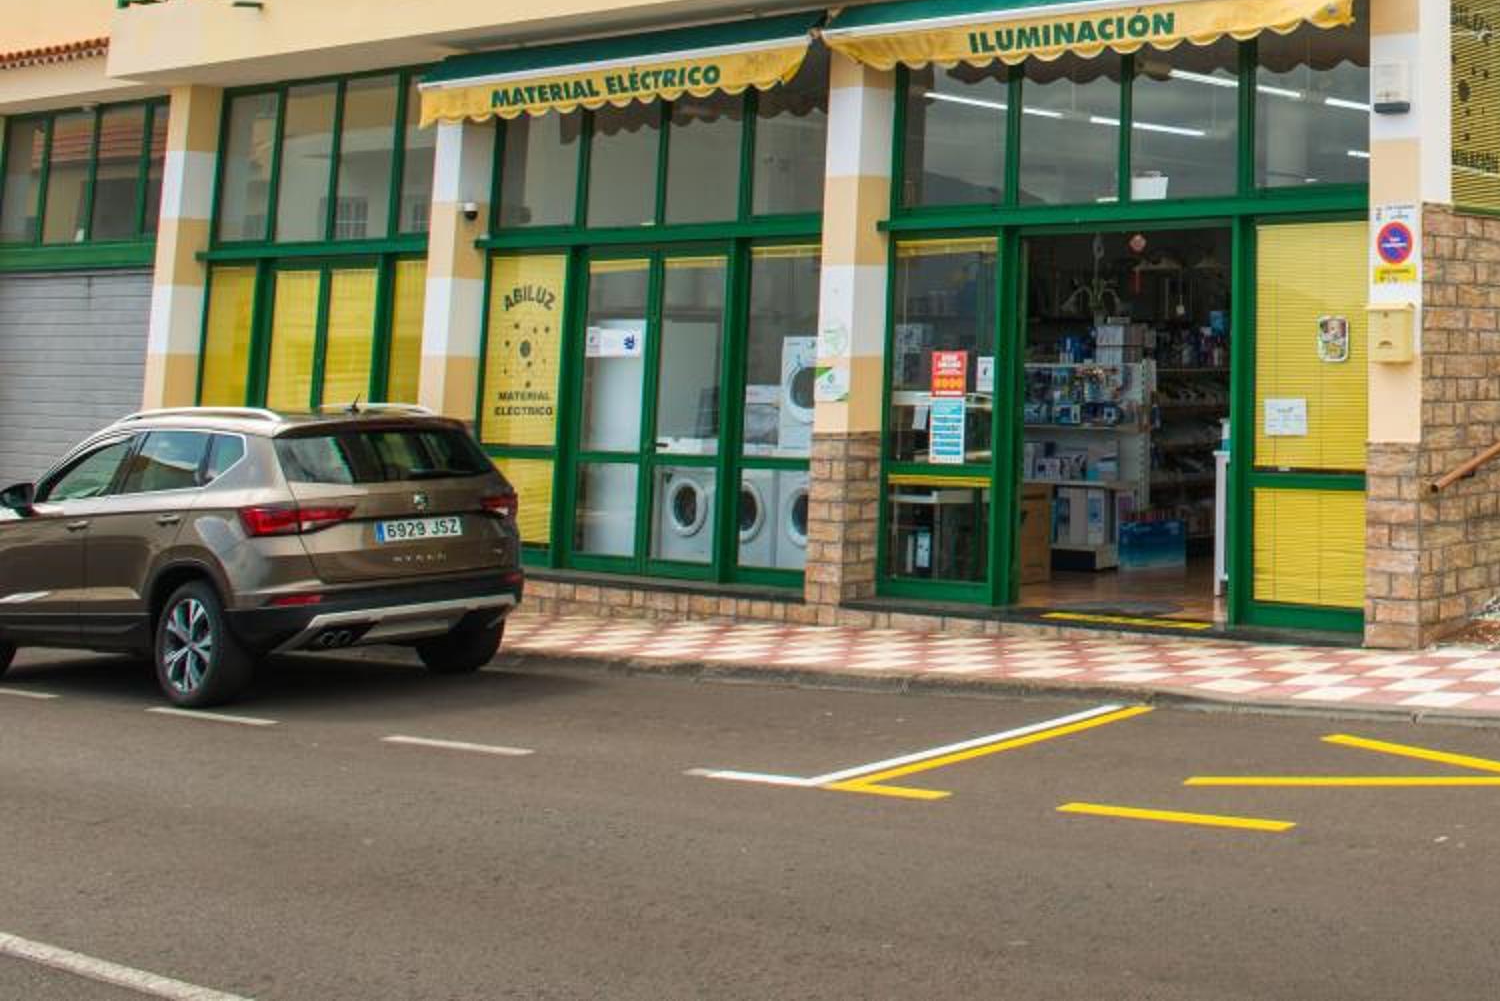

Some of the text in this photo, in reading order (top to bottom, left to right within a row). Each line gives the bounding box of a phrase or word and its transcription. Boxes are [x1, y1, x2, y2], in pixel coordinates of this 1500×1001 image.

[968, 6, 1176, 55] ILUMINACIÓN
[490, 64, 721, 109] MATERIAL ELÉCTRICO
[503, 284, 556, 312] ABILUZ
[497, 390, 551, 401] MATERIAL
[386, 518, 459, 538] 6929 JSZ
